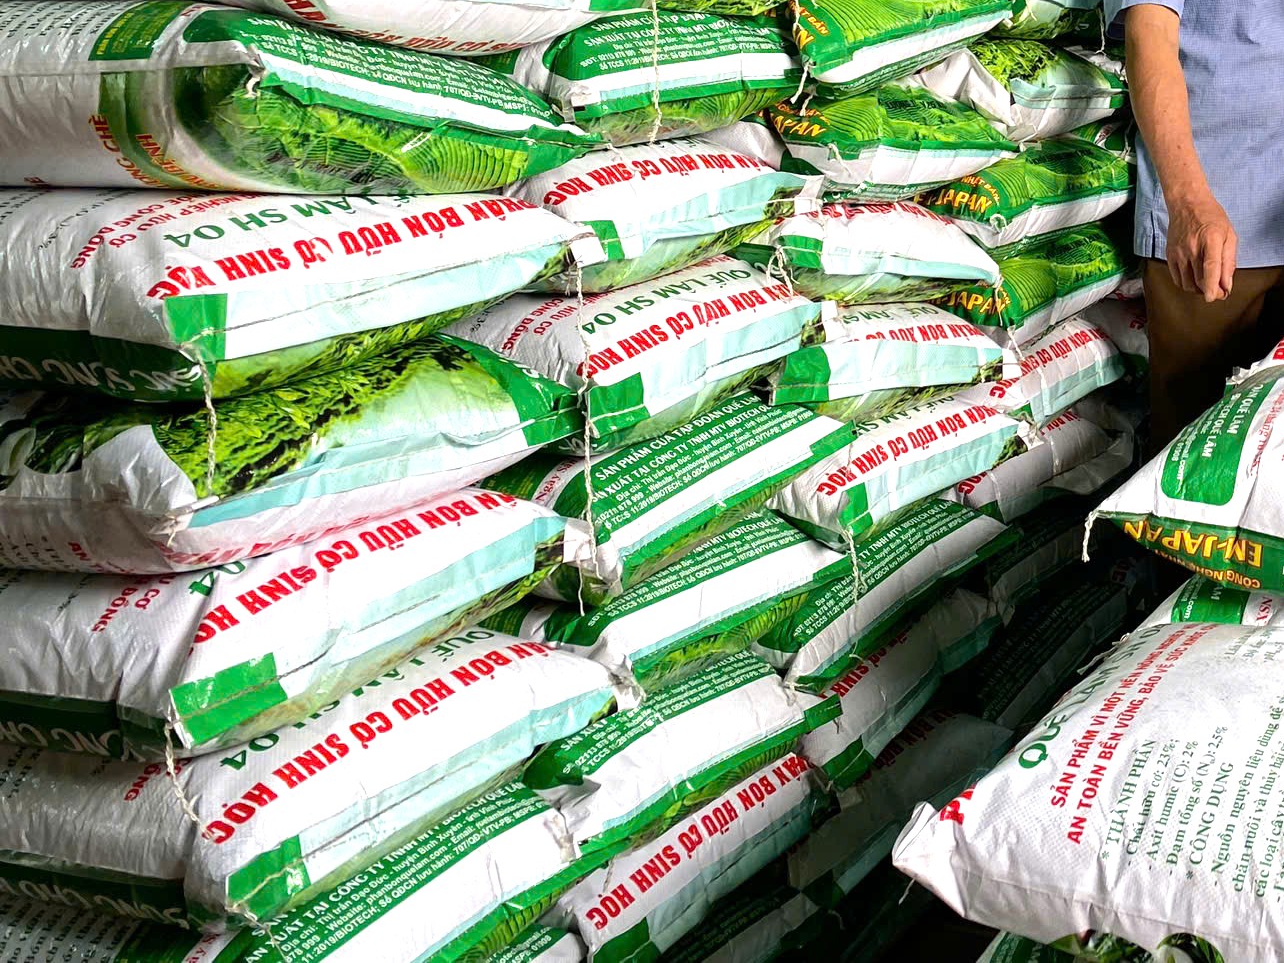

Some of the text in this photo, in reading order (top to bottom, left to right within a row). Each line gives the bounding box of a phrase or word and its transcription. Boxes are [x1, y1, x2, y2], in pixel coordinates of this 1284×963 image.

[70, 203, 164, 269] CỘNG ĐỒNG
[108, 233, 137, 248] CƠ
[163, 207, 289, 248] SH 04
[337, 224, 402, 257] HỮU
[406, 207, 466, 240] BÓN
[215, 246, 291, 281] SINH
[581, 294, 656, 335] SH 04
[619, 310, 695, 359] CƠ SINH
[595, 463, 619, 481] SẢN
[618, 446, 651, 470] PHẨM
[650, 434, 675, 451] CỦA
[676, 422, 694, 439] TẬP
[606, 472, 634, 494] XUẤT
[632, 463, 649, 479] TẠI
[650, 448, 677, 469] CÔNG
[676, 442, 689, 457] TY
[688, 428, 715, 451] TNHH
[853, 416, 967, 475] BÓN HỮU CƠ SINH
[234, 495, 476, 615] BÓN HỮU CƠ SINH
[1124, 520, 1263, 568] EM-JAPAN
[391, 684, 456, 723] HỮU
[348, 711, 392, 746] CƠ
[1050, 687, 1125, 808] SẢN PHẨM VÌ MỘT
[271, 742, 353, 790] SINH
[1067, 674, 1163, 845] AN TOÀN BỀN VỮNG, BẢO
[202, 778, 280, 845] HỌC
[1106, 740, 1156, 845] THÀNH PHẦN
[1146, 741, 1198, 861] Axit humic 2%
[1189, 762, 1233, 865] CÔNG DỤNG
[1126, 823, 1144, 855] Chất
[1166, 797, 1200, 866] Đạm tổng
[1211, 772, 1254, 874] Nguồn nguyên
[302, 860, 385, 921] TẠI CÔNG TY
[630, 845, 681, 893] SINH
[1232, 855, 1249, 892] chăn
[1255, 869, 1270, 898] các
[586, 884, 634, 930] HỌC
